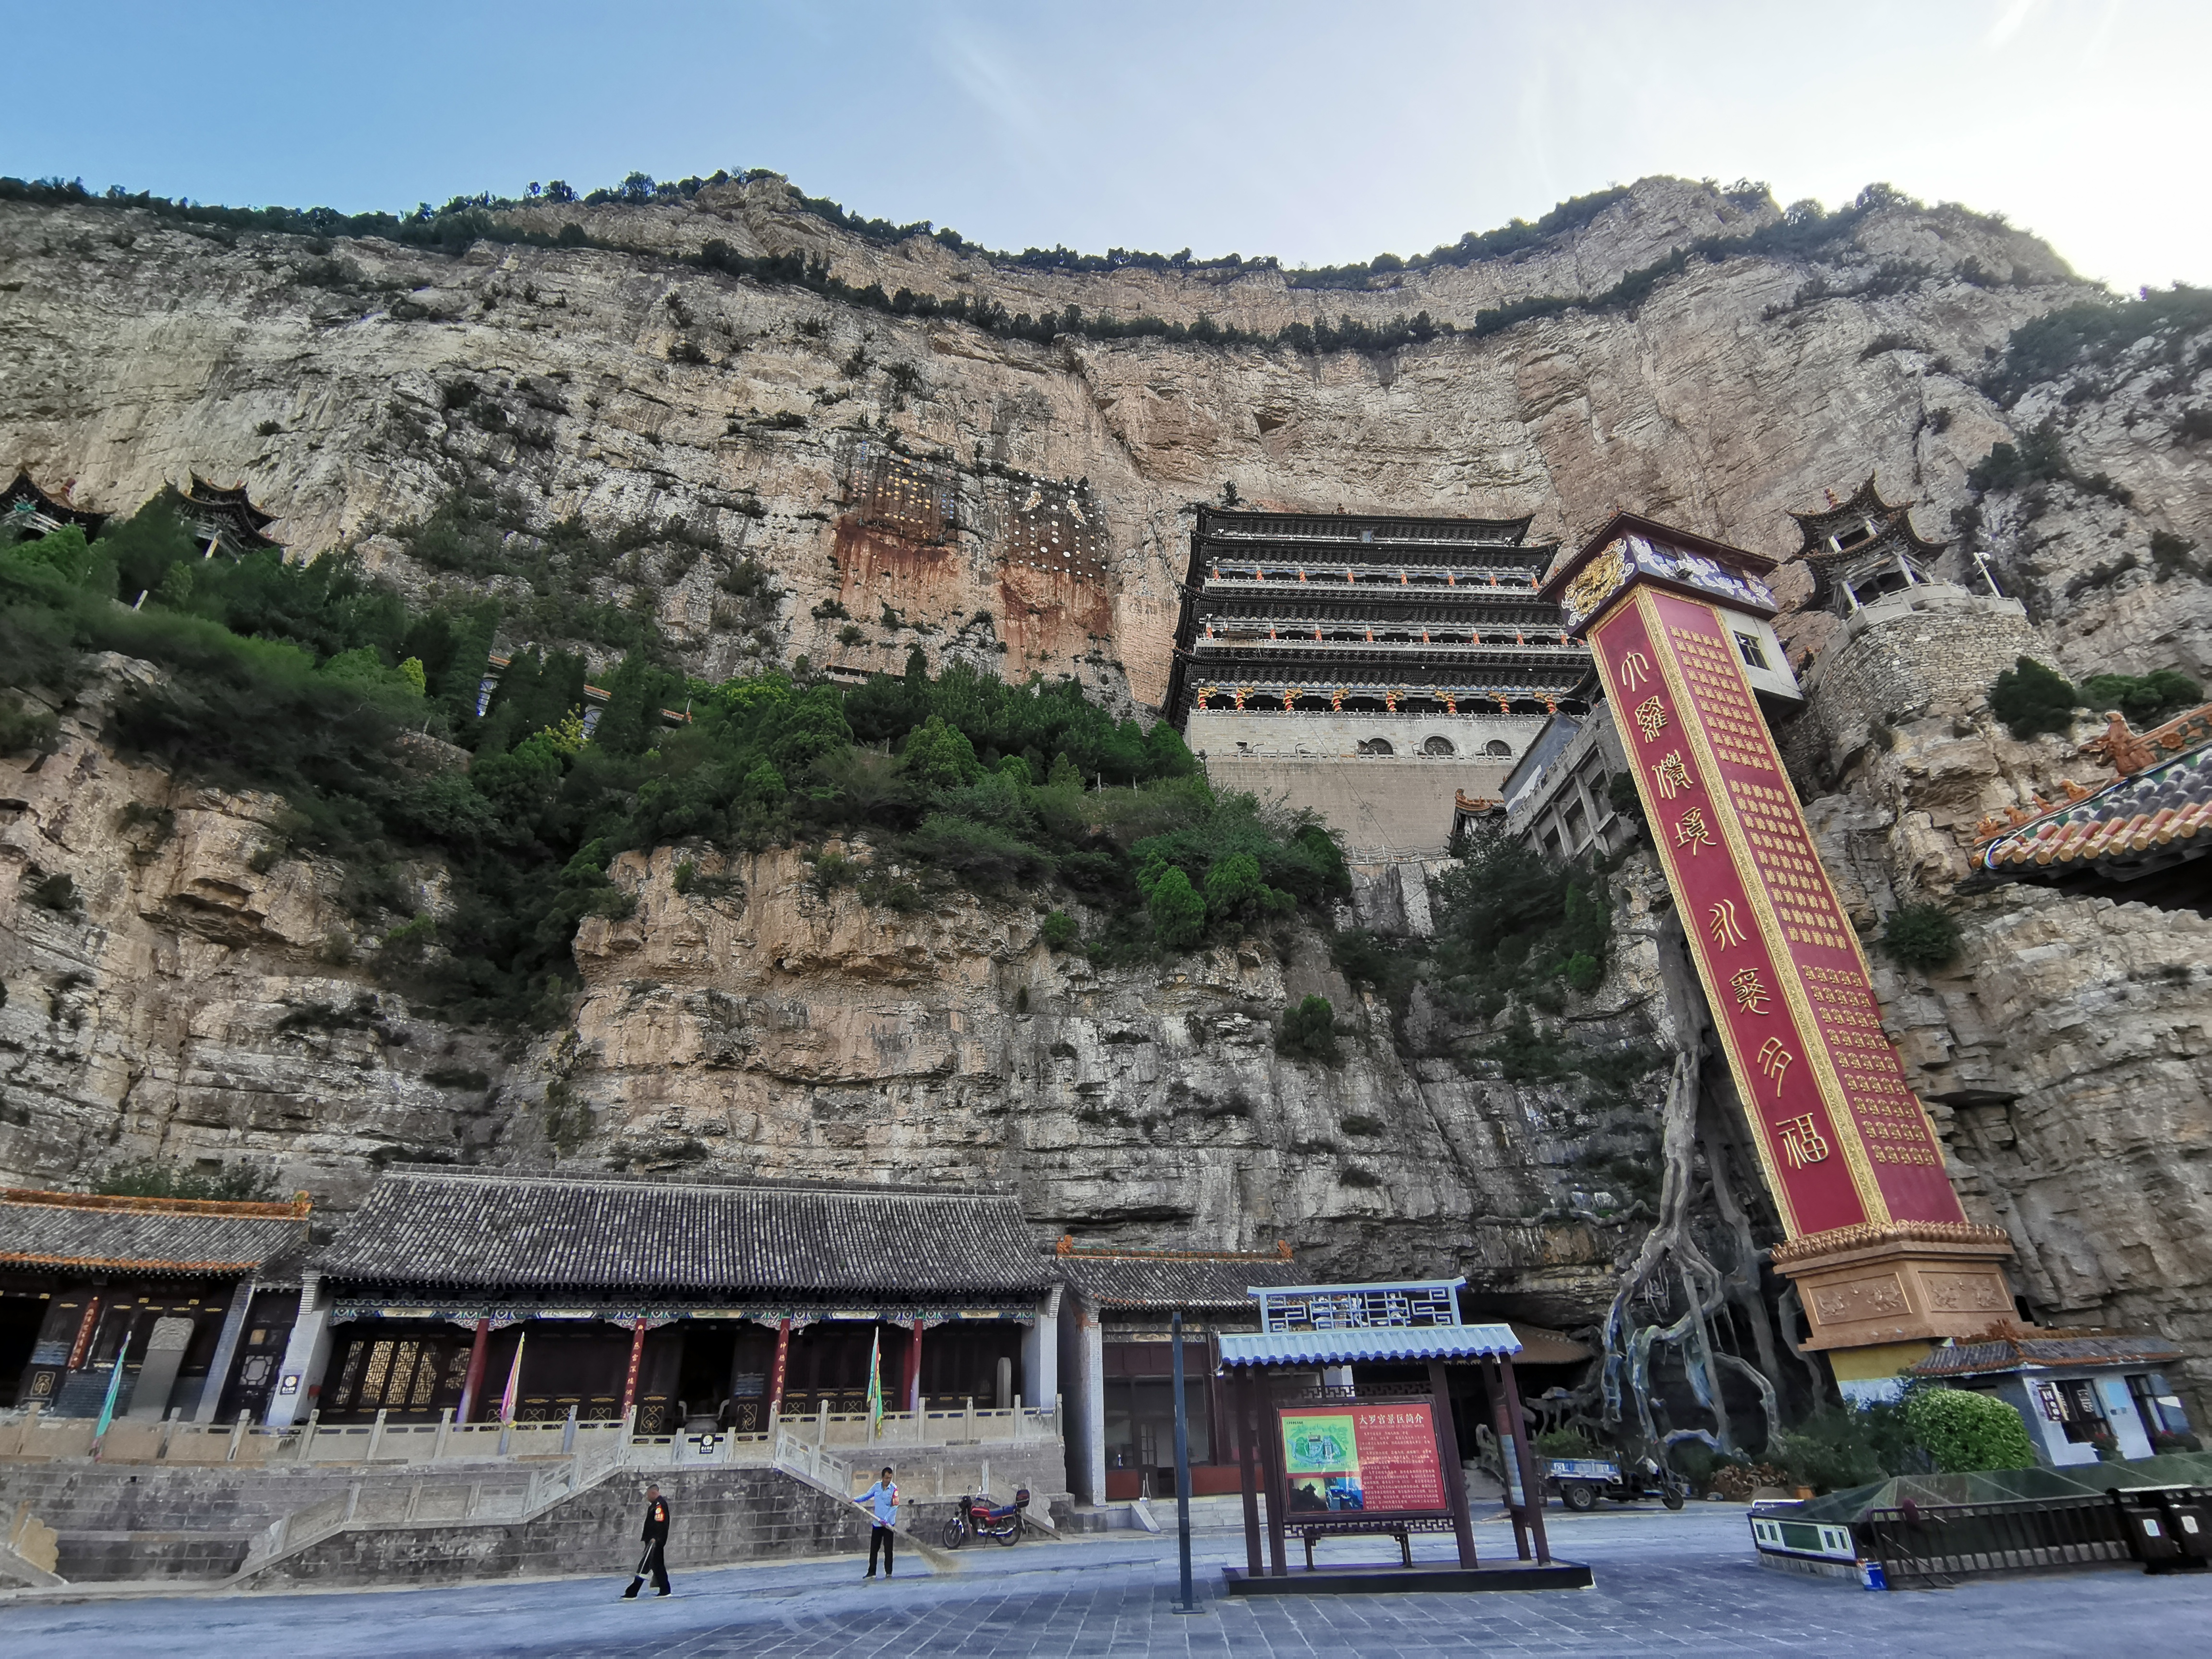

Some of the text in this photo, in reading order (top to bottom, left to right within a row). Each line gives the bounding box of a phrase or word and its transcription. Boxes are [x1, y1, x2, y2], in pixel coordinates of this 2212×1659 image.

[1358, 1412, 1424, 1425] 大罗宫景区简介
